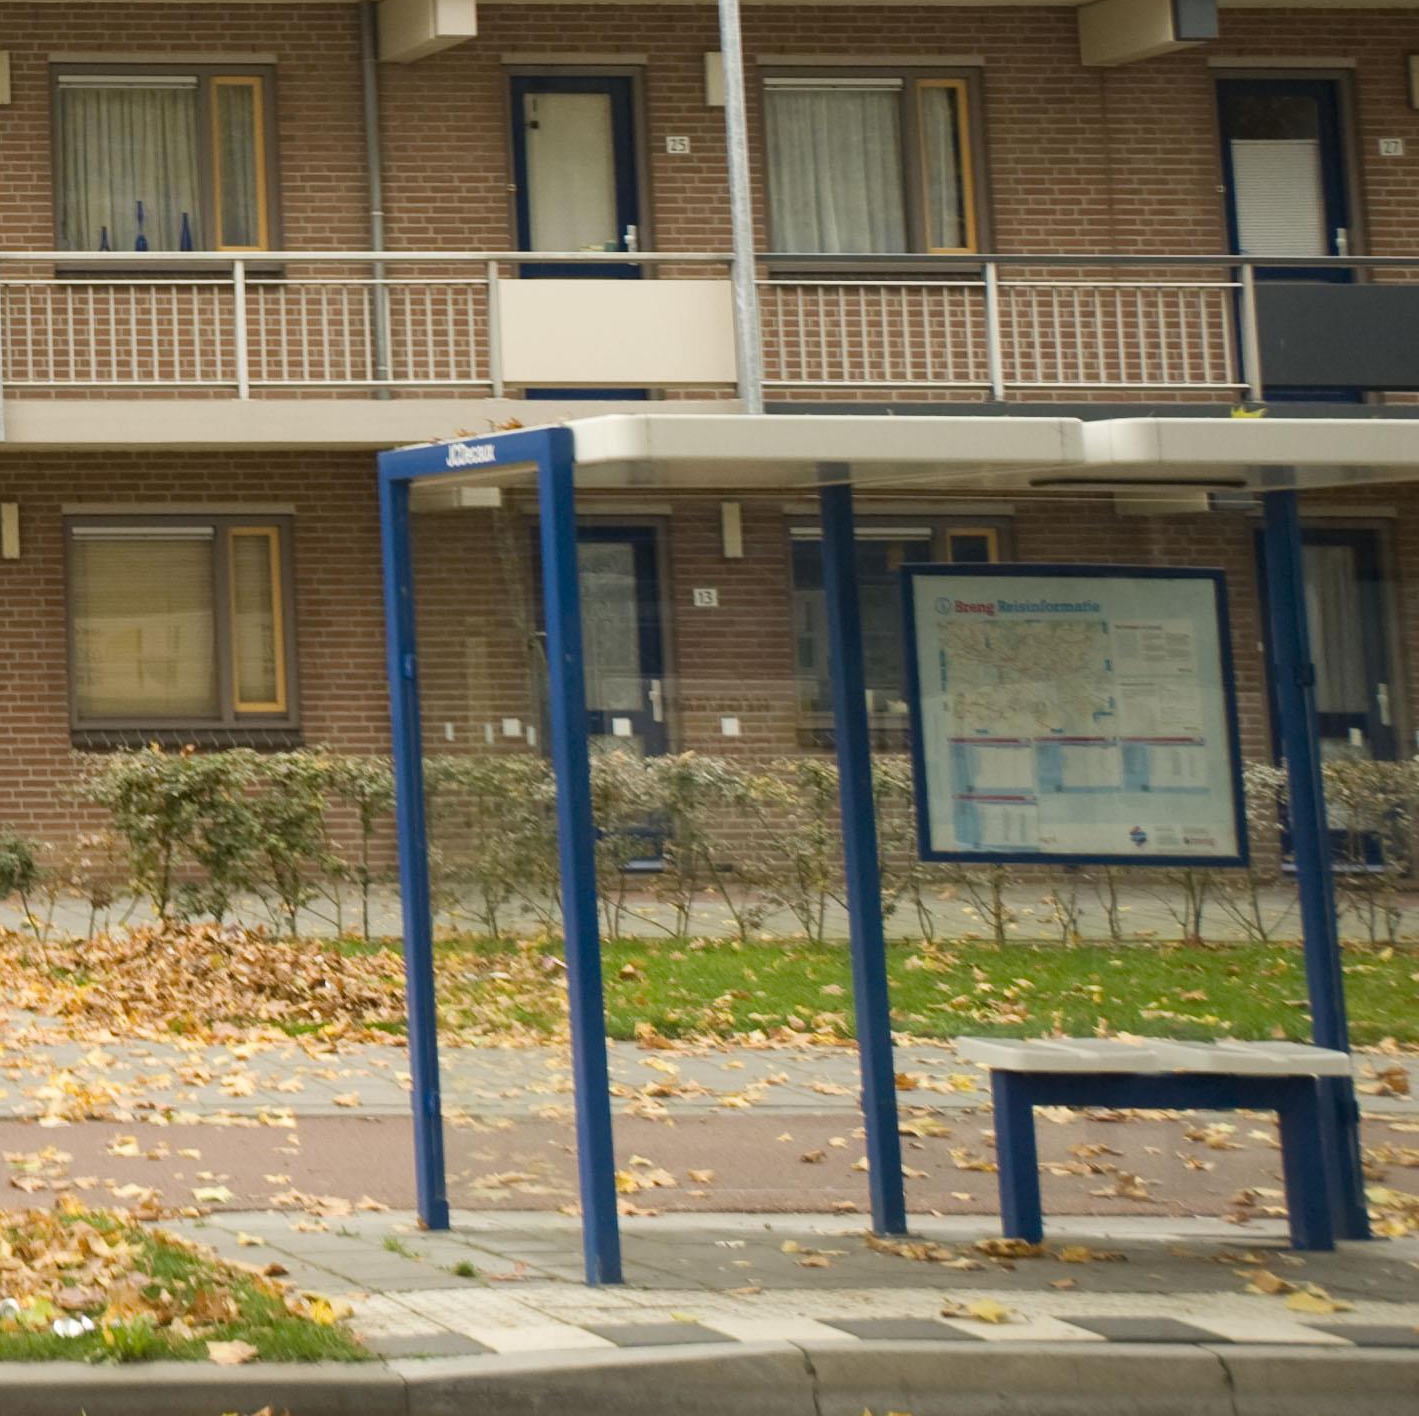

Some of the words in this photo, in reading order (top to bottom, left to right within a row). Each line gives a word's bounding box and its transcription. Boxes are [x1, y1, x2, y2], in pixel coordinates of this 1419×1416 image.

[671, 138, 686, 152] 25
[698, 590, 712, 604] 13
[954, 599, 996, 617] Breng
[997, 599, 1100, 613] Reisinformatie
